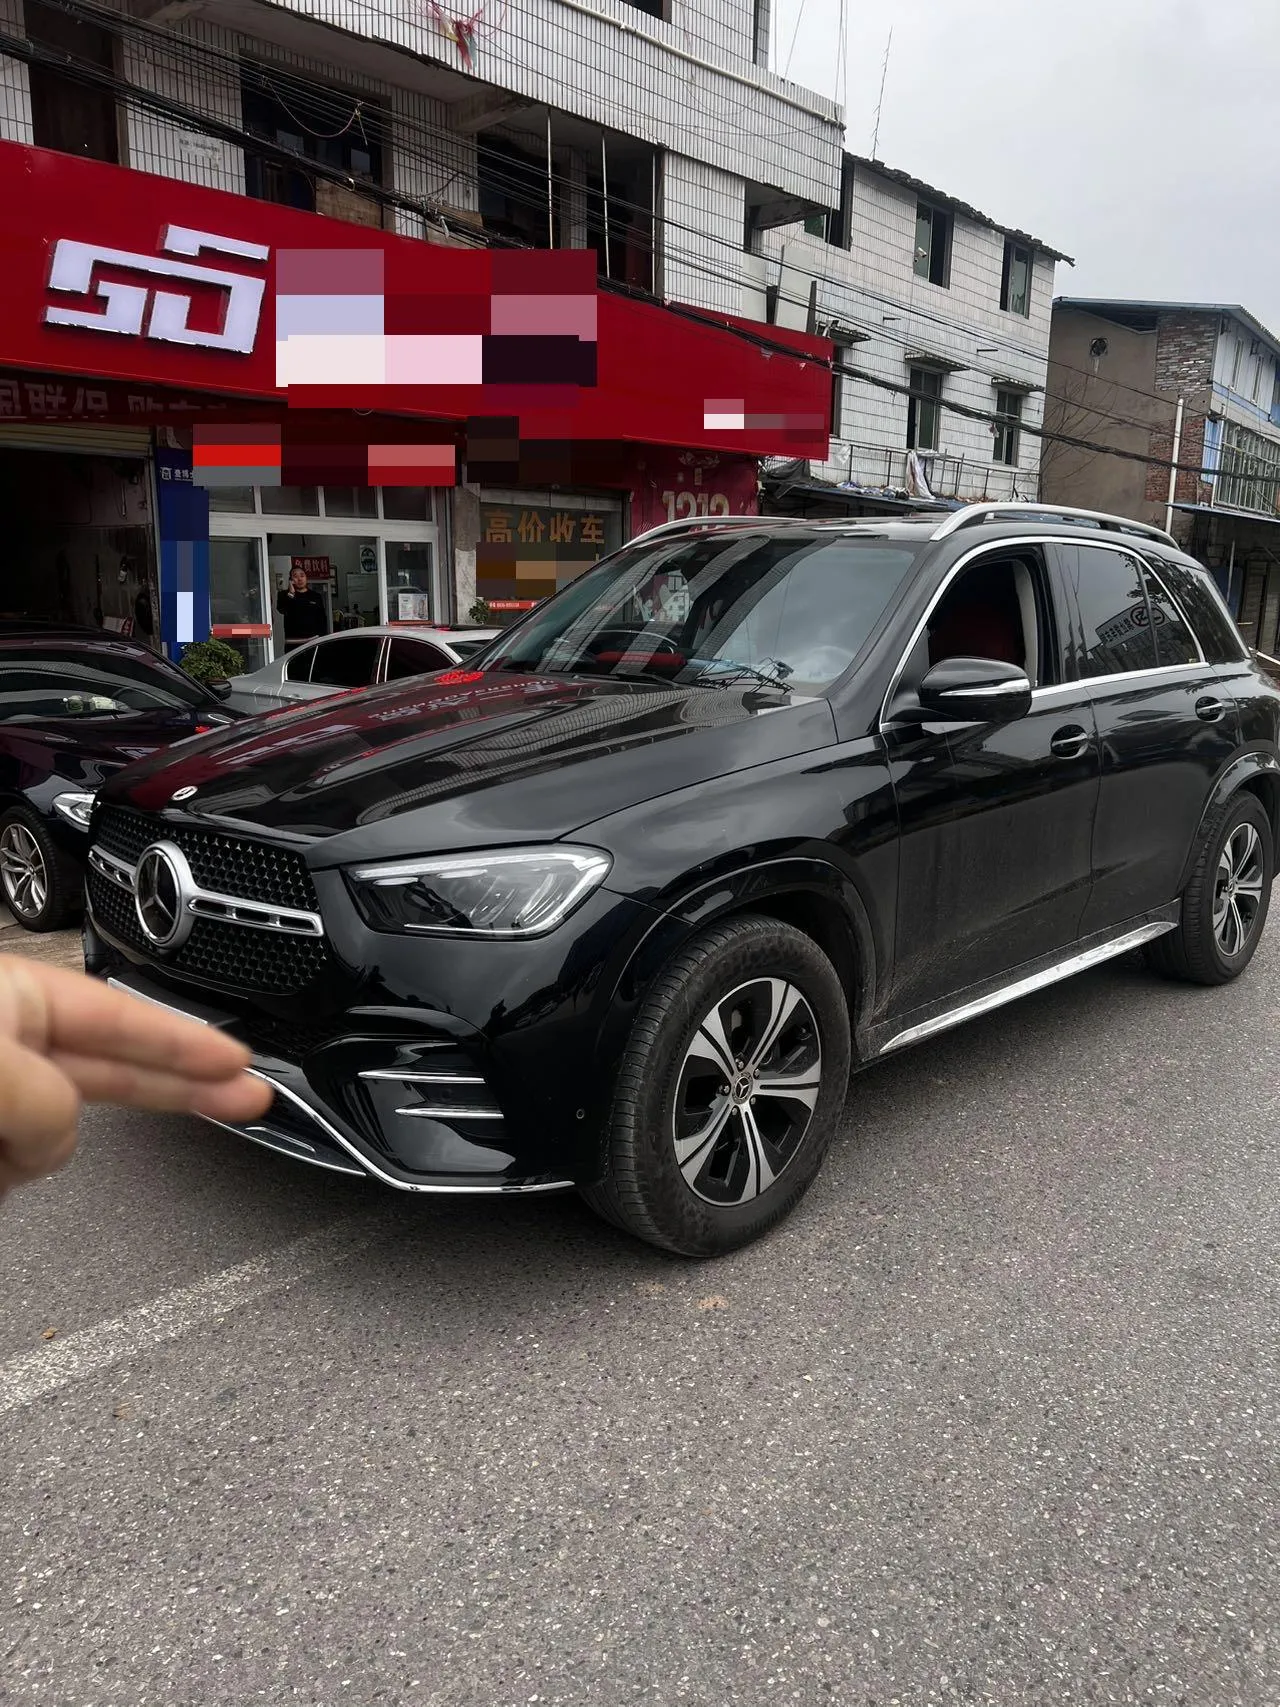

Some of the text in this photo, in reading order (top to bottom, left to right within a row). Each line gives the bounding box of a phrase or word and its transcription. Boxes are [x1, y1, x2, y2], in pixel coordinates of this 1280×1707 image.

[484, 508, 605, 544] 高价收车
[662, 490, 730, 529] 1212
